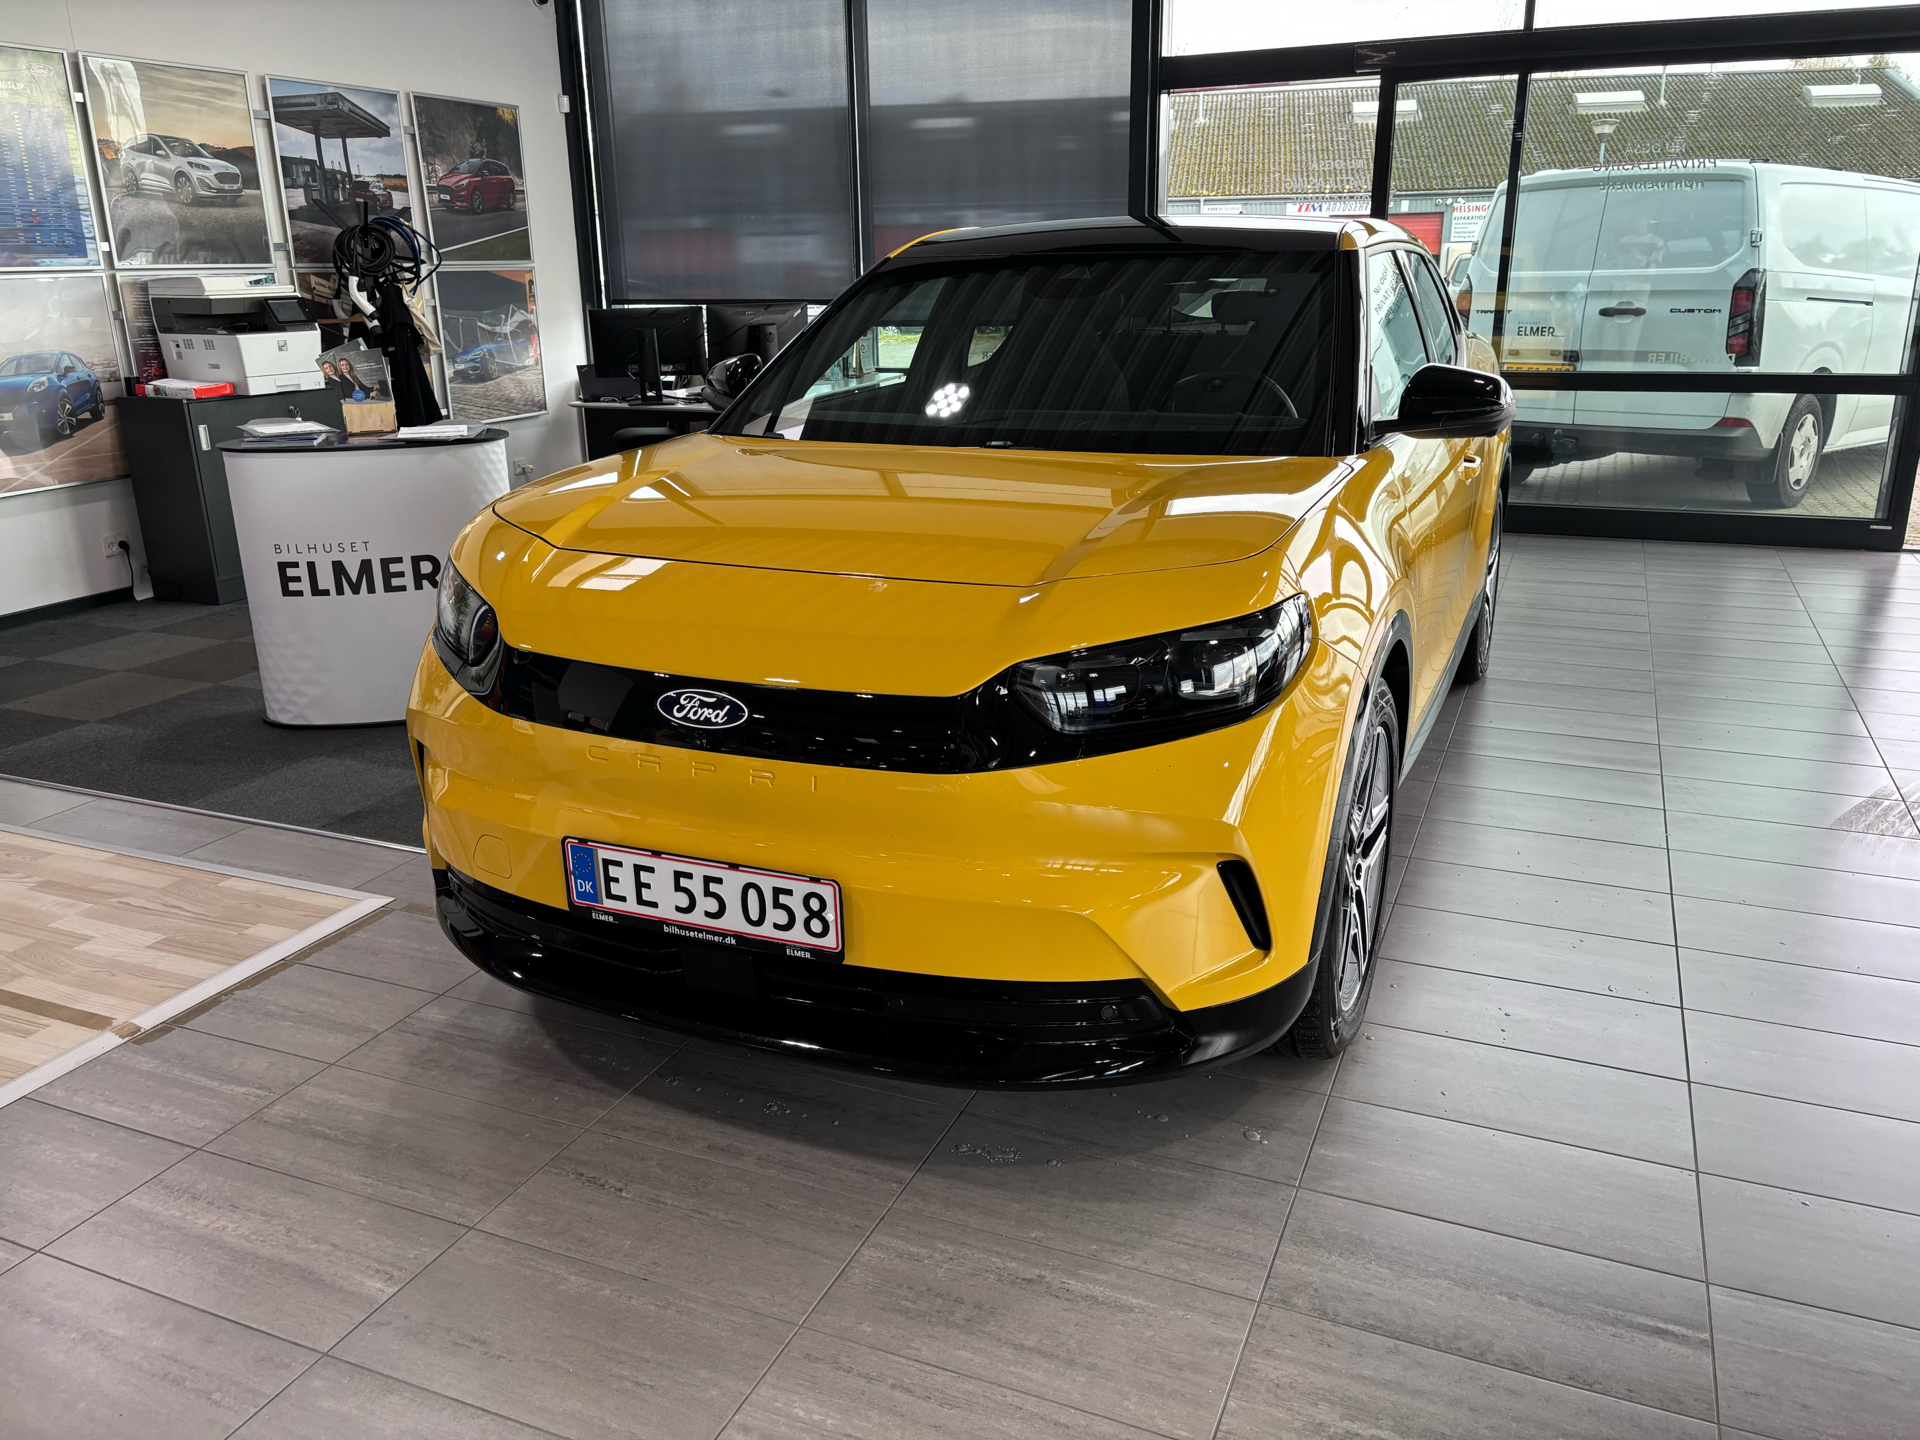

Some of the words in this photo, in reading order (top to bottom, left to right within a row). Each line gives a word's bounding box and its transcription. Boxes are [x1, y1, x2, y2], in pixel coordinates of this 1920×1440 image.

[1325, 203, 1370, 212] AUTOSERV
[1517, 326, 1556, 337] ELMER
[274, 541, 371, 555] BILHUSET
[276, 554, 440, 598] ELMER
[673, 693, 730, 724] Ford
[586, 745, 818, 793] CAPRI
[577, 879, 595, 895] DK
[601, 857, 659, 910] EE
[672, 869, 727, 920] 55
[741, 882, 831, 939] 058
[592, 912, 614, 923] ELMER
[663, 924, 737, 946] bilhusetelmer.dk
[786, 948, 811, 959] ELMER
